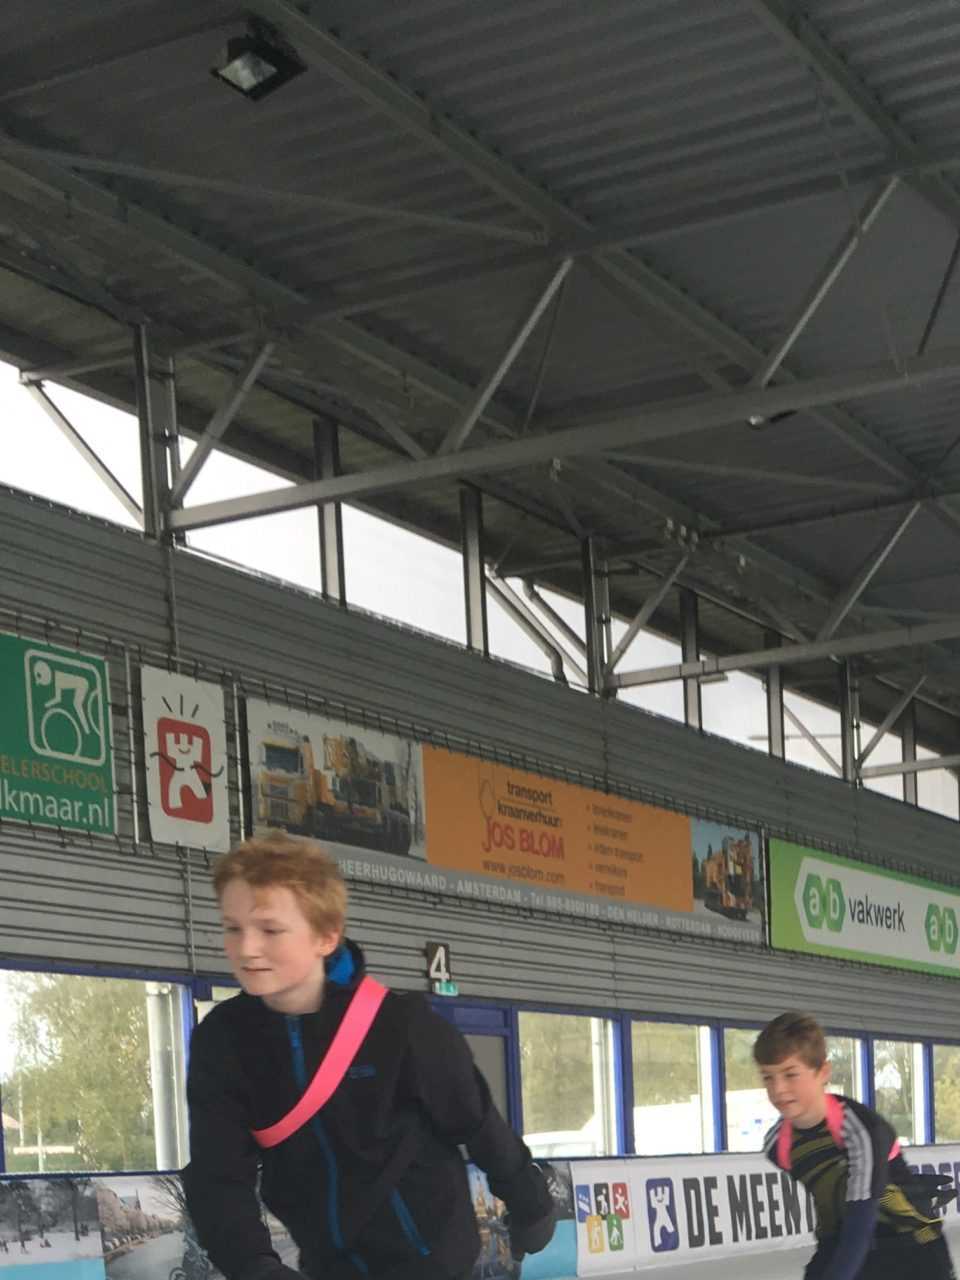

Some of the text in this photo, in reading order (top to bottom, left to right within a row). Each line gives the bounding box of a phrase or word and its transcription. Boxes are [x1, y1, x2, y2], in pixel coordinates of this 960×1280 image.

[507, 780, 553, 806] transport
[481, 816, 515, 853] JOS
[519, 829, 565, 860] BLOM
[338, 859, 447, 890] HEERHUGOWAARD
[457, 880, 521, 904] AMSTERDAM
[849, 894, 906, 932] vakwerk
[430, 945, 450, 982] 4
[683, 1176, 724, 1249] DE
